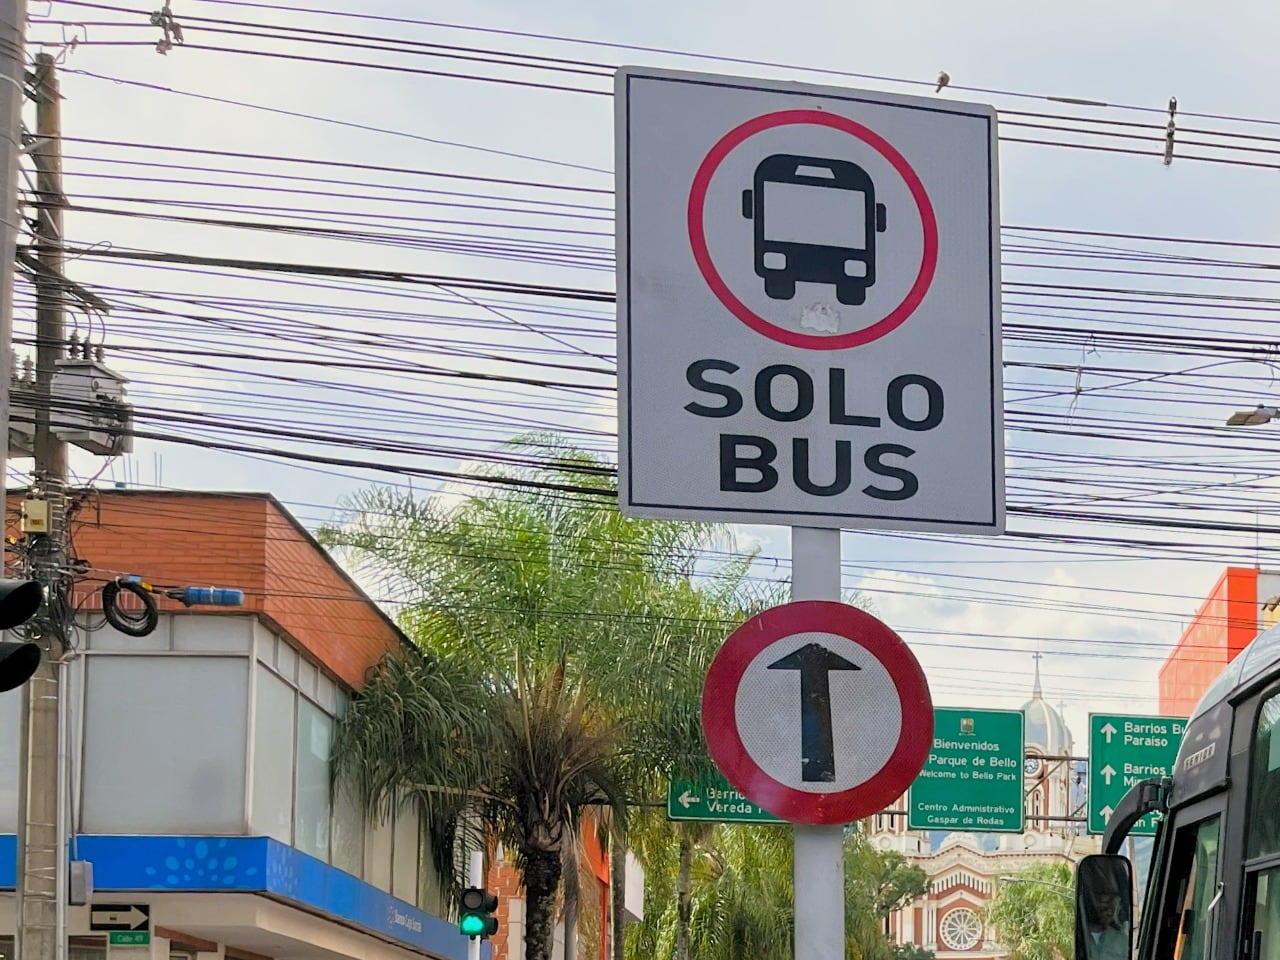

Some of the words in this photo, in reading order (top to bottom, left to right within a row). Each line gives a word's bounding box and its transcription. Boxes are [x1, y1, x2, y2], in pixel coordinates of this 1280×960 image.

[683, 358, 945, 432] SOLO
[719, 433, 919, 501] BUS
[1124, 722, 1167, 734] Barrios
[933, 739, 1000, 752] Bienvenidos
[928, 754, 968, 768] Parque
[972, 756, 985, 766] de
[989, 757, 1017, 768] Bello
[919, 769, 957, 779] Welcome
[960, 770, 969, 779] to
[972, 770, 994, 780] Bello
[996, 772, 1017, 781] Park
[1123, 763, 1166, 775] Barrios
[706, 800, 752, 814] Vereda
[918, 802, 948, 811] Centro
[952, 803, 1015, 814] Administrativo
[927, 815, 959, 825] Gaspar
[962, 816, 973, 824] de
[976, 816, 1004, 826] Rodas
